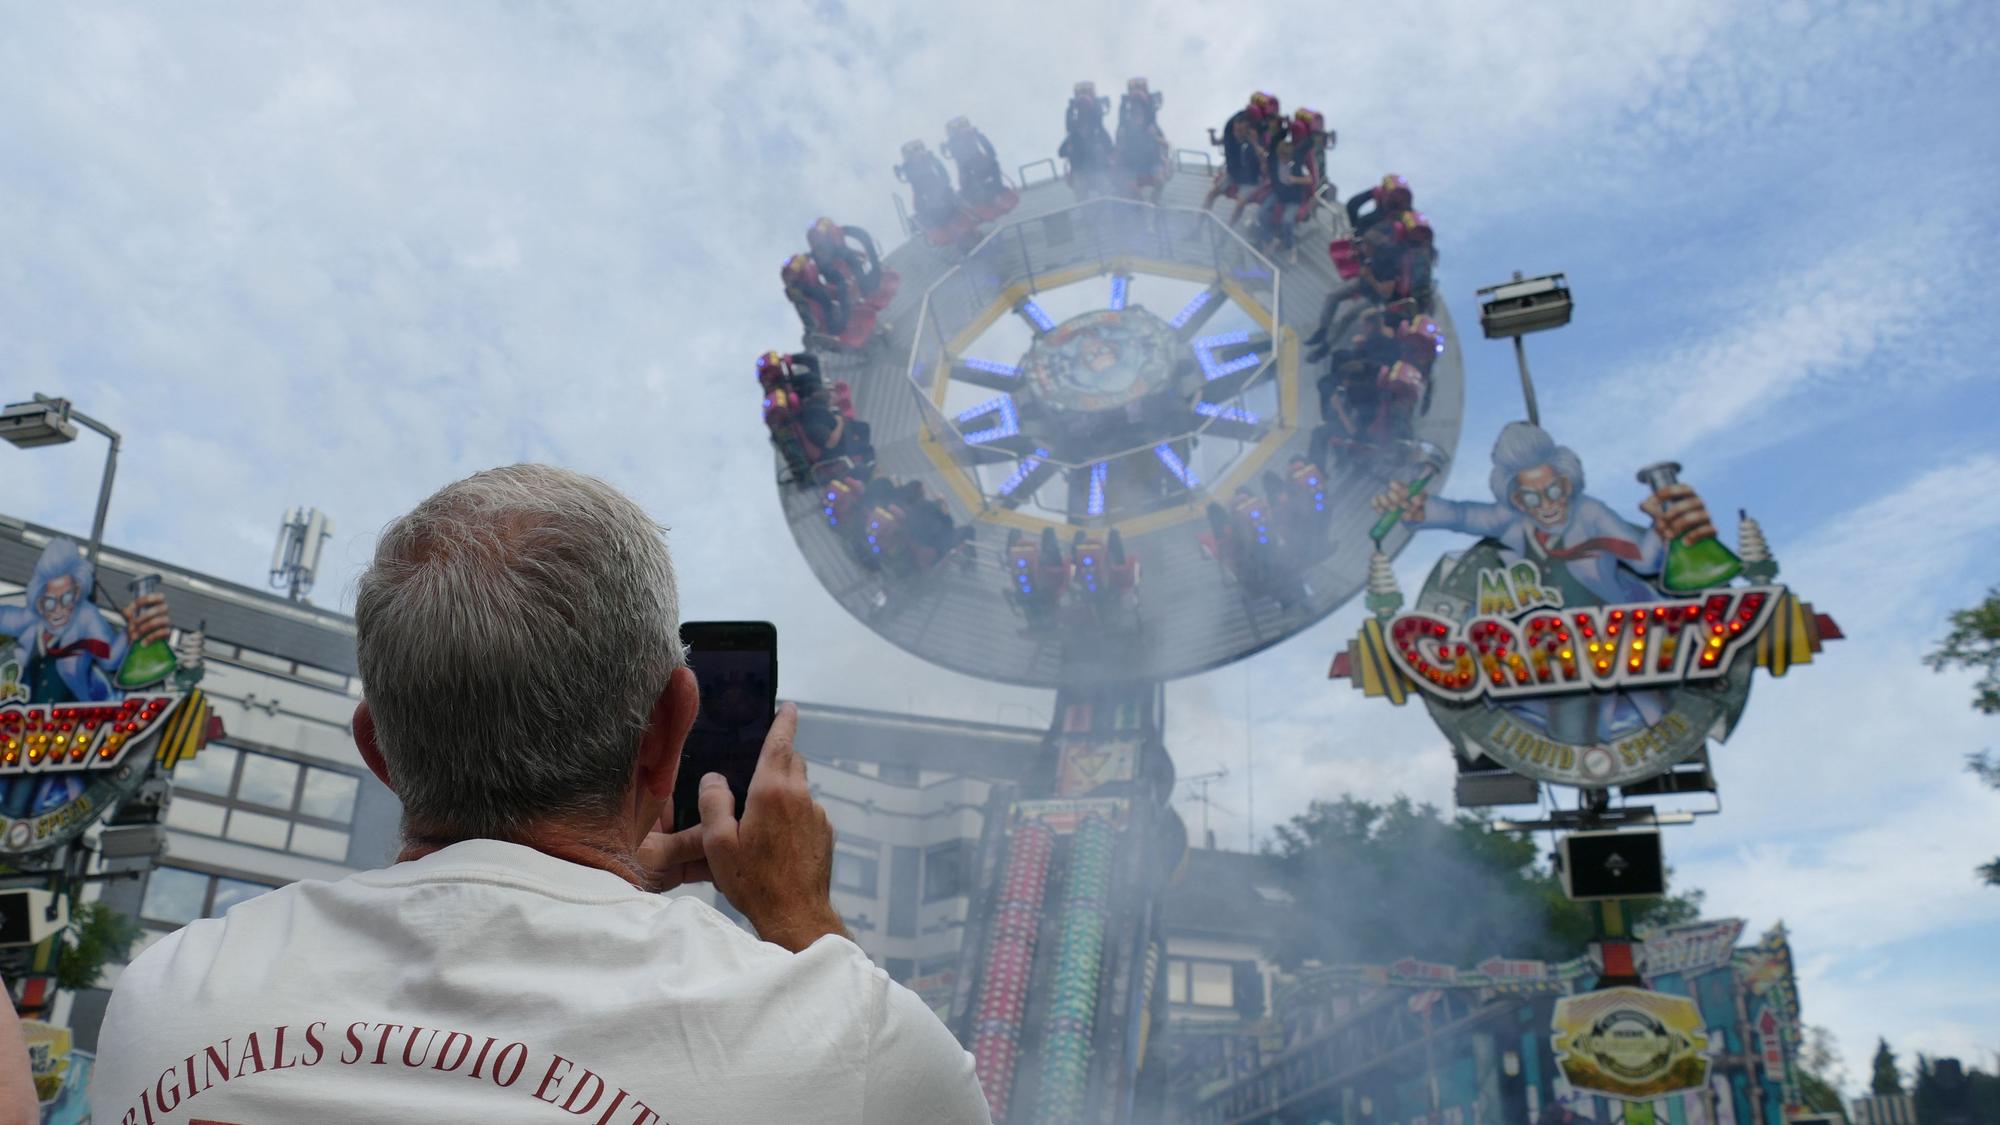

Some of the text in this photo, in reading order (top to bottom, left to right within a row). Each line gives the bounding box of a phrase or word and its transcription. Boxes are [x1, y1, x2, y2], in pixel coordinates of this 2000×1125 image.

[1479, 560, 1562, 617] MR.
[1388, 587, 1778, 699] GRAVITY
[1491, 712, 1689, 769] LIQUID SPEED
[340, 1021, 528, 1088] STUDIO
[531, 1054, 669, 1125] EDIT
